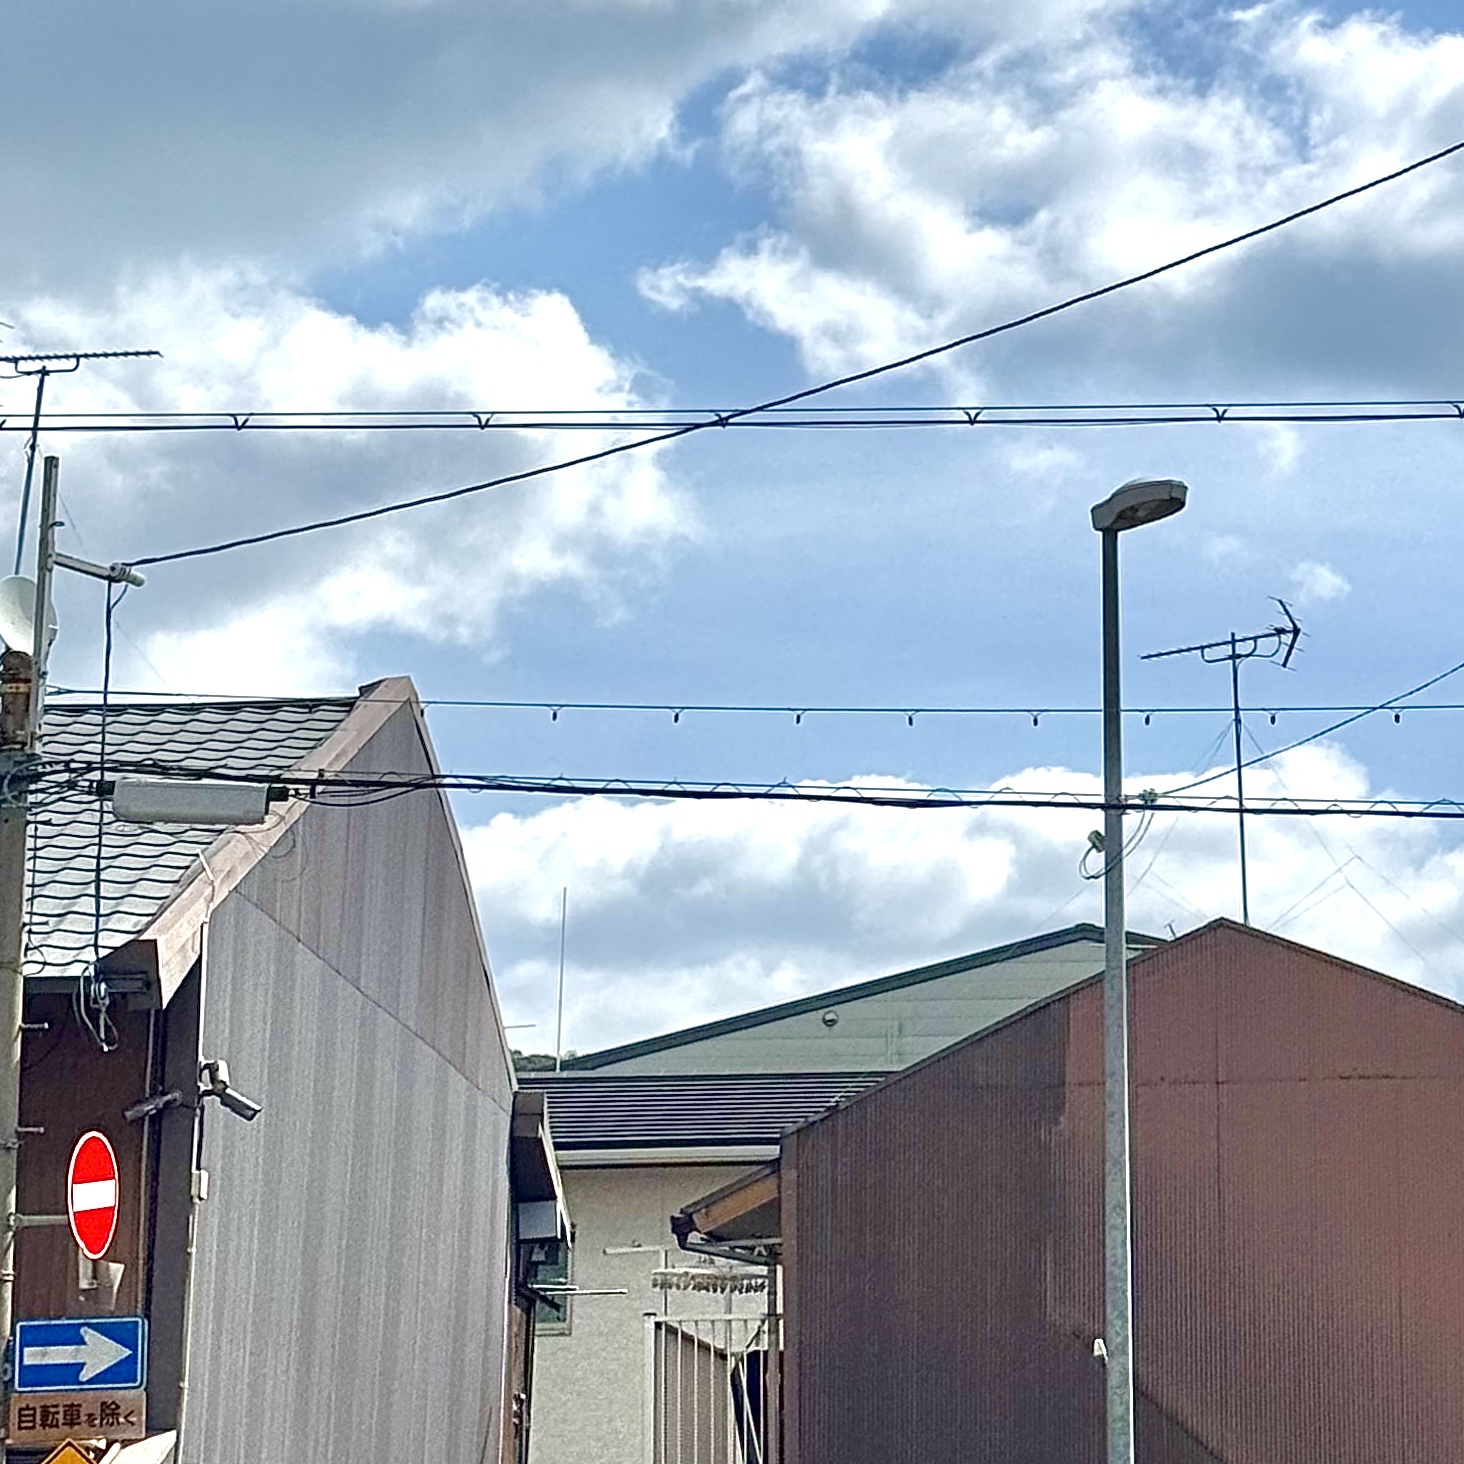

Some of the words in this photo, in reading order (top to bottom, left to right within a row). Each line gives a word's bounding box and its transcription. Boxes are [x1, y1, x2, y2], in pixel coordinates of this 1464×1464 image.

[17, 1401, 136, 1430] 自転車を除く
